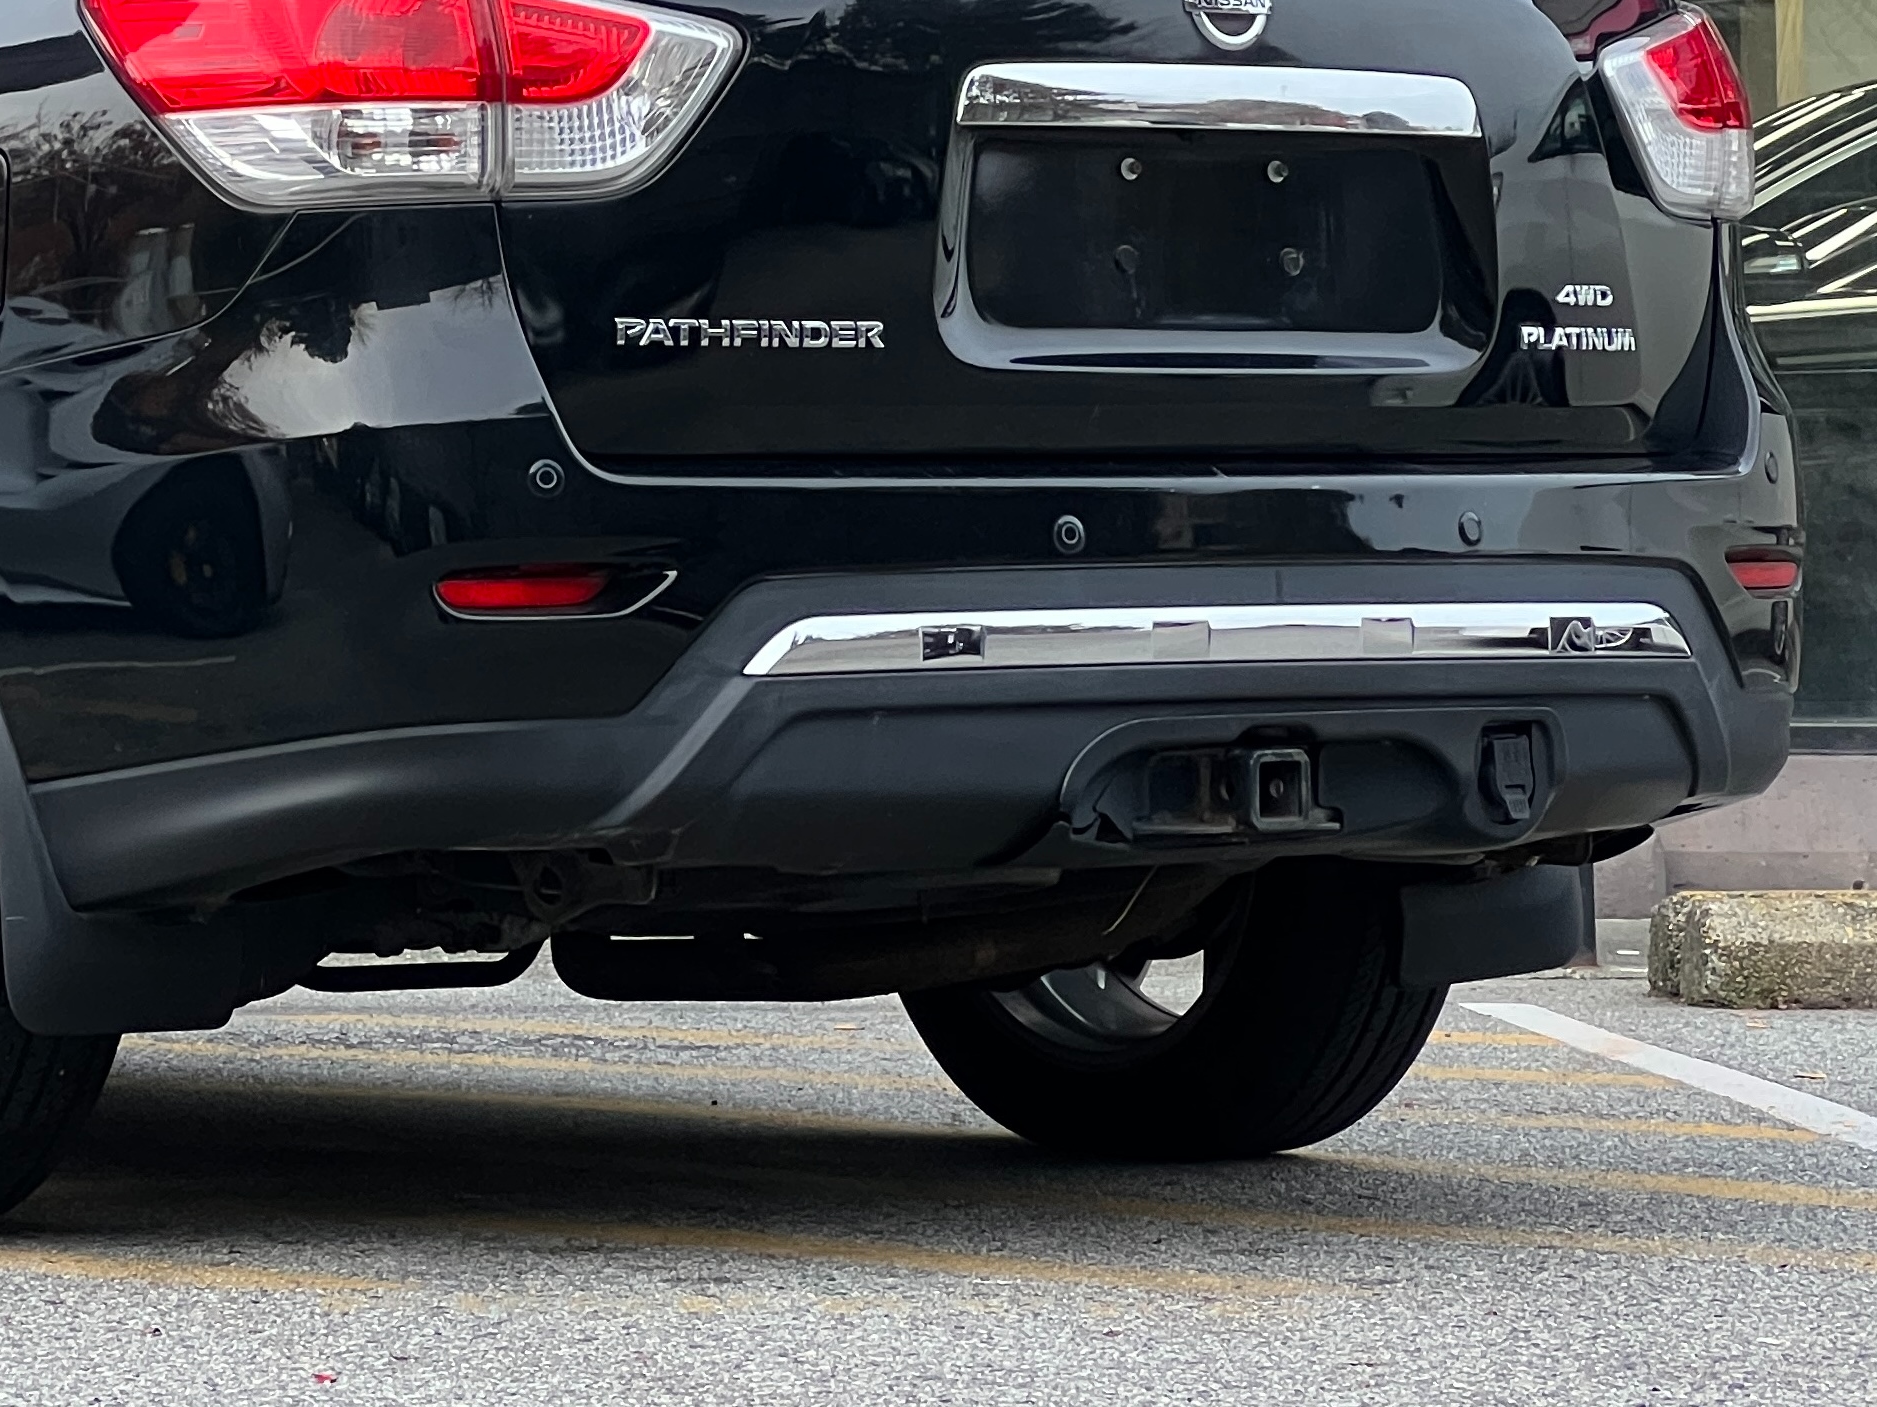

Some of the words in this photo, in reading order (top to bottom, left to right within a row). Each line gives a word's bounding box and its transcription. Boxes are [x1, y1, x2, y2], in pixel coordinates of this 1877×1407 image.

[1555, 283, 1615, 307] 4WD
[613, 316, 885, 348] PATHFINDER
[1519, 325, 1637, 351] PLATINUM
